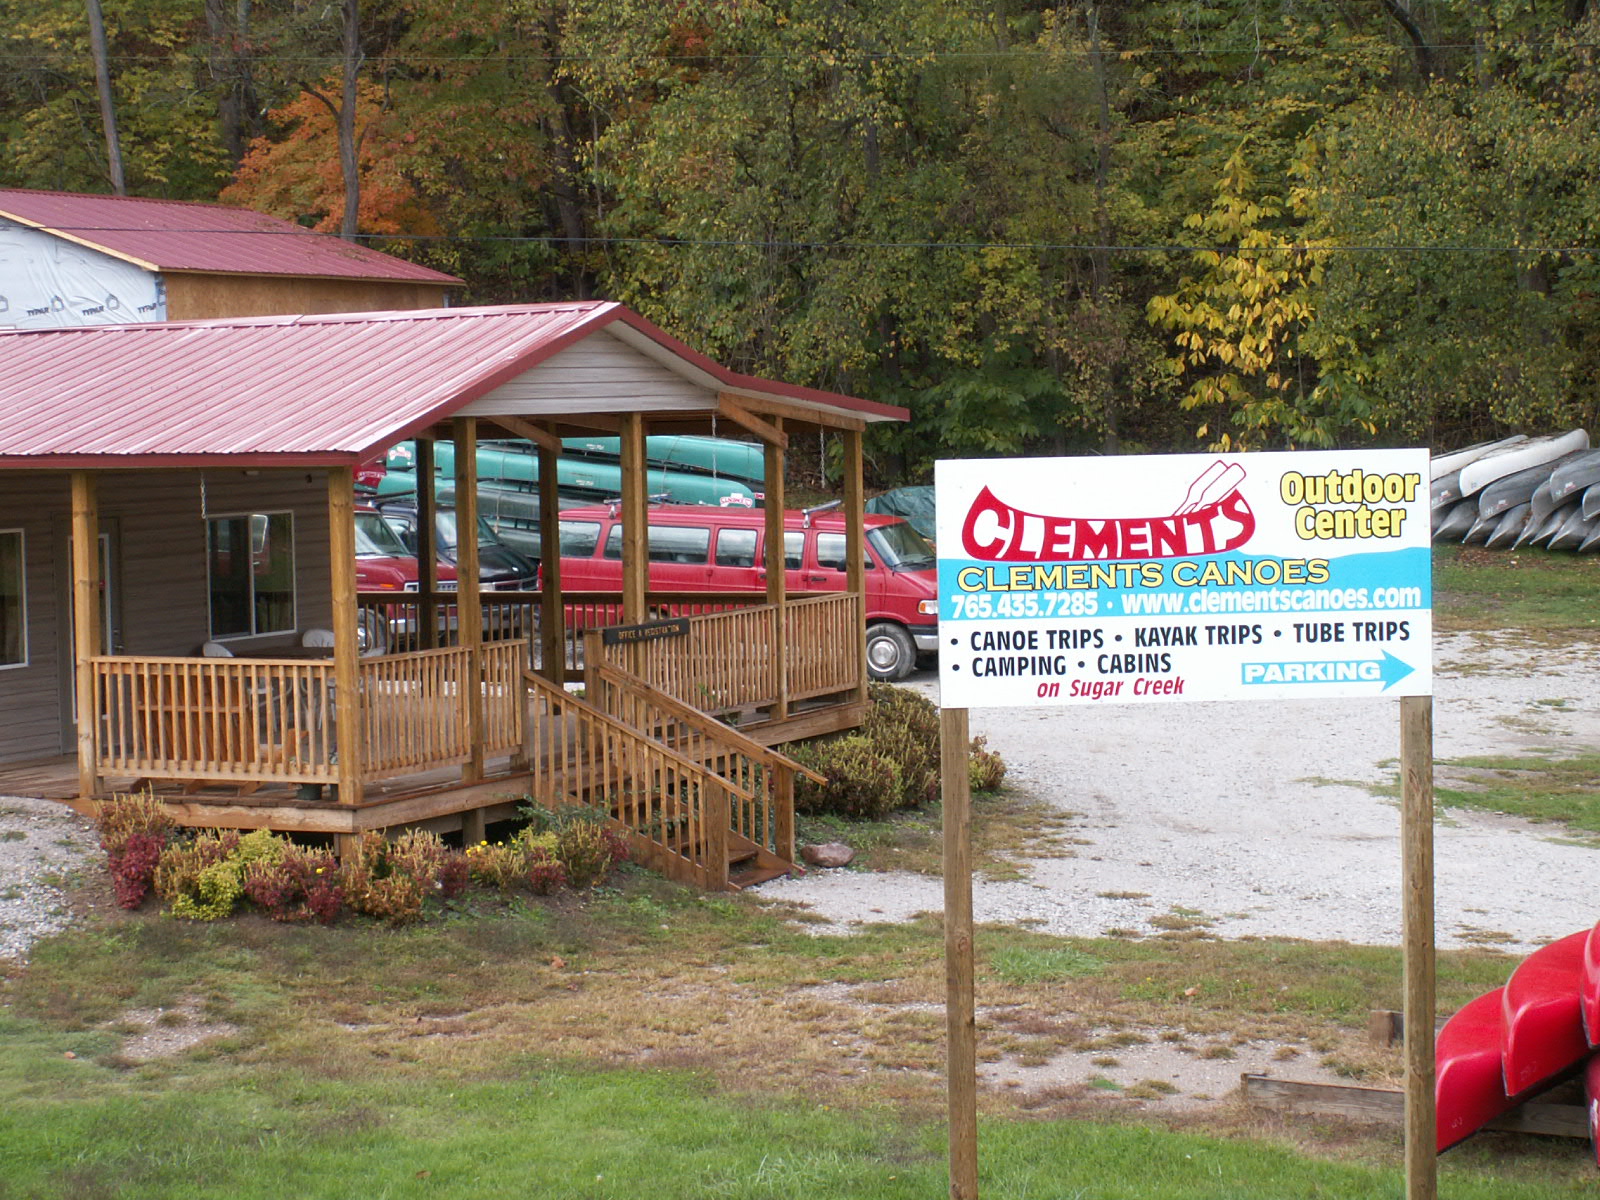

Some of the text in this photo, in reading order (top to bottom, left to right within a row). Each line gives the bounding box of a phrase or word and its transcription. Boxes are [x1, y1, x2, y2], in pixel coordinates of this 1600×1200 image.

[1279, 469, 1421, 505] Outdoor
[961, 485, 1256, 562] CLEMENTS
[1294, 503, 1407, 540] Center
[956, 558, 1330, 593] CLEMENTS CANOES
[951, 586, 1421, 619] 765.435.7285 www.clementscanoes.com
[970, 620, 1410, 651] CANOE TRIPS KAYAK TRIPS TUBE TRIPS
[972, 652, 1172, 677] CAMPING CABINS
[1244, 661, 1382, 683] PARKING
[1037, 676, 1185, 701] on Sugar Creek
